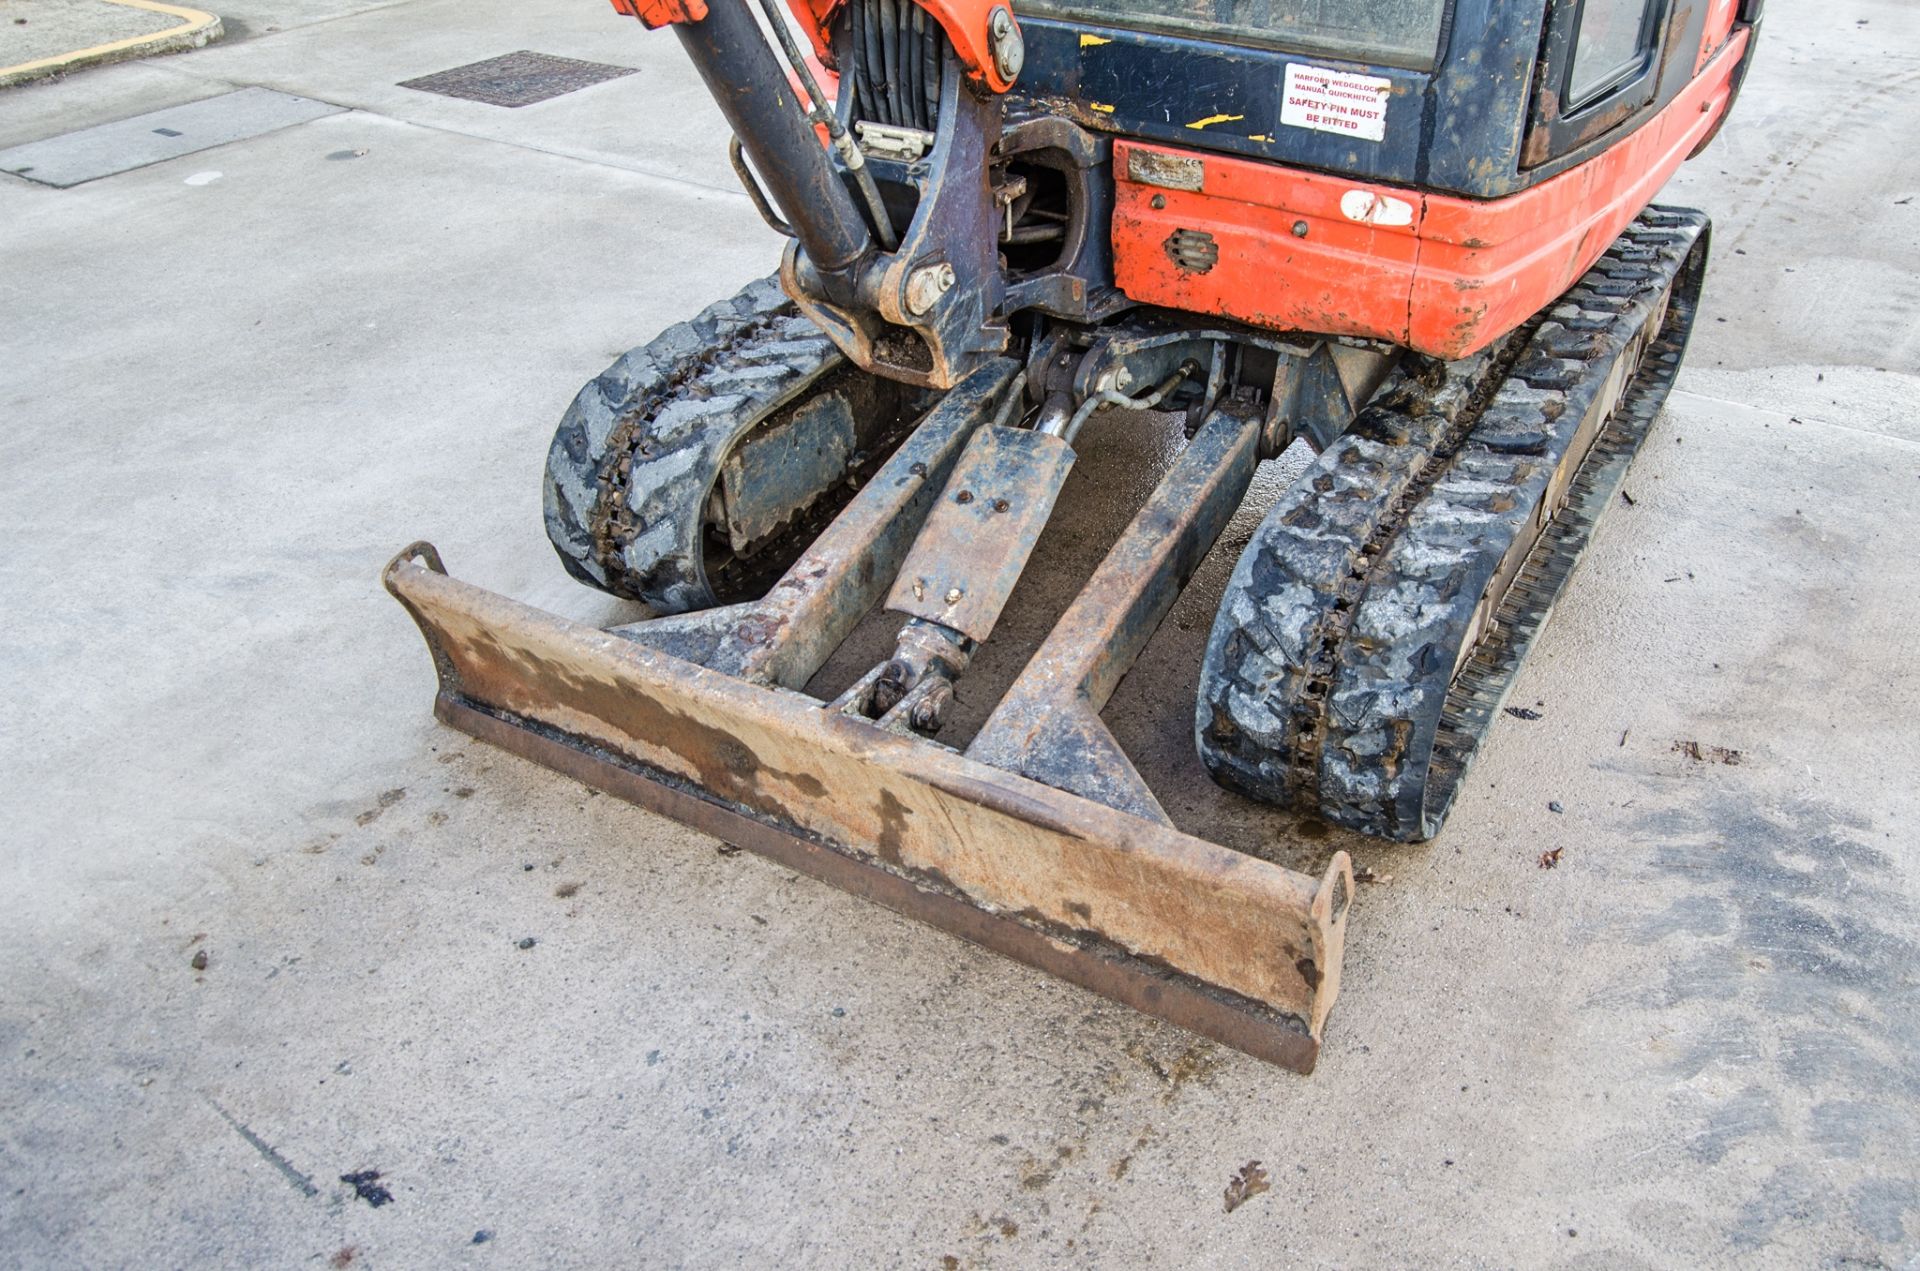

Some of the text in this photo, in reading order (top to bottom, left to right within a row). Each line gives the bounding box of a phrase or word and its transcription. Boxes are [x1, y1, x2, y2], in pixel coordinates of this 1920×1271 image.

[1294, 73, 1330, 84] HARFORD
[1295, 84, 1377, 103] MANUAL QUICKHITCH
[1289, 97, 1380, 120] SAFETY PIN MUST
[1306, 113, 1320, 123] BE
